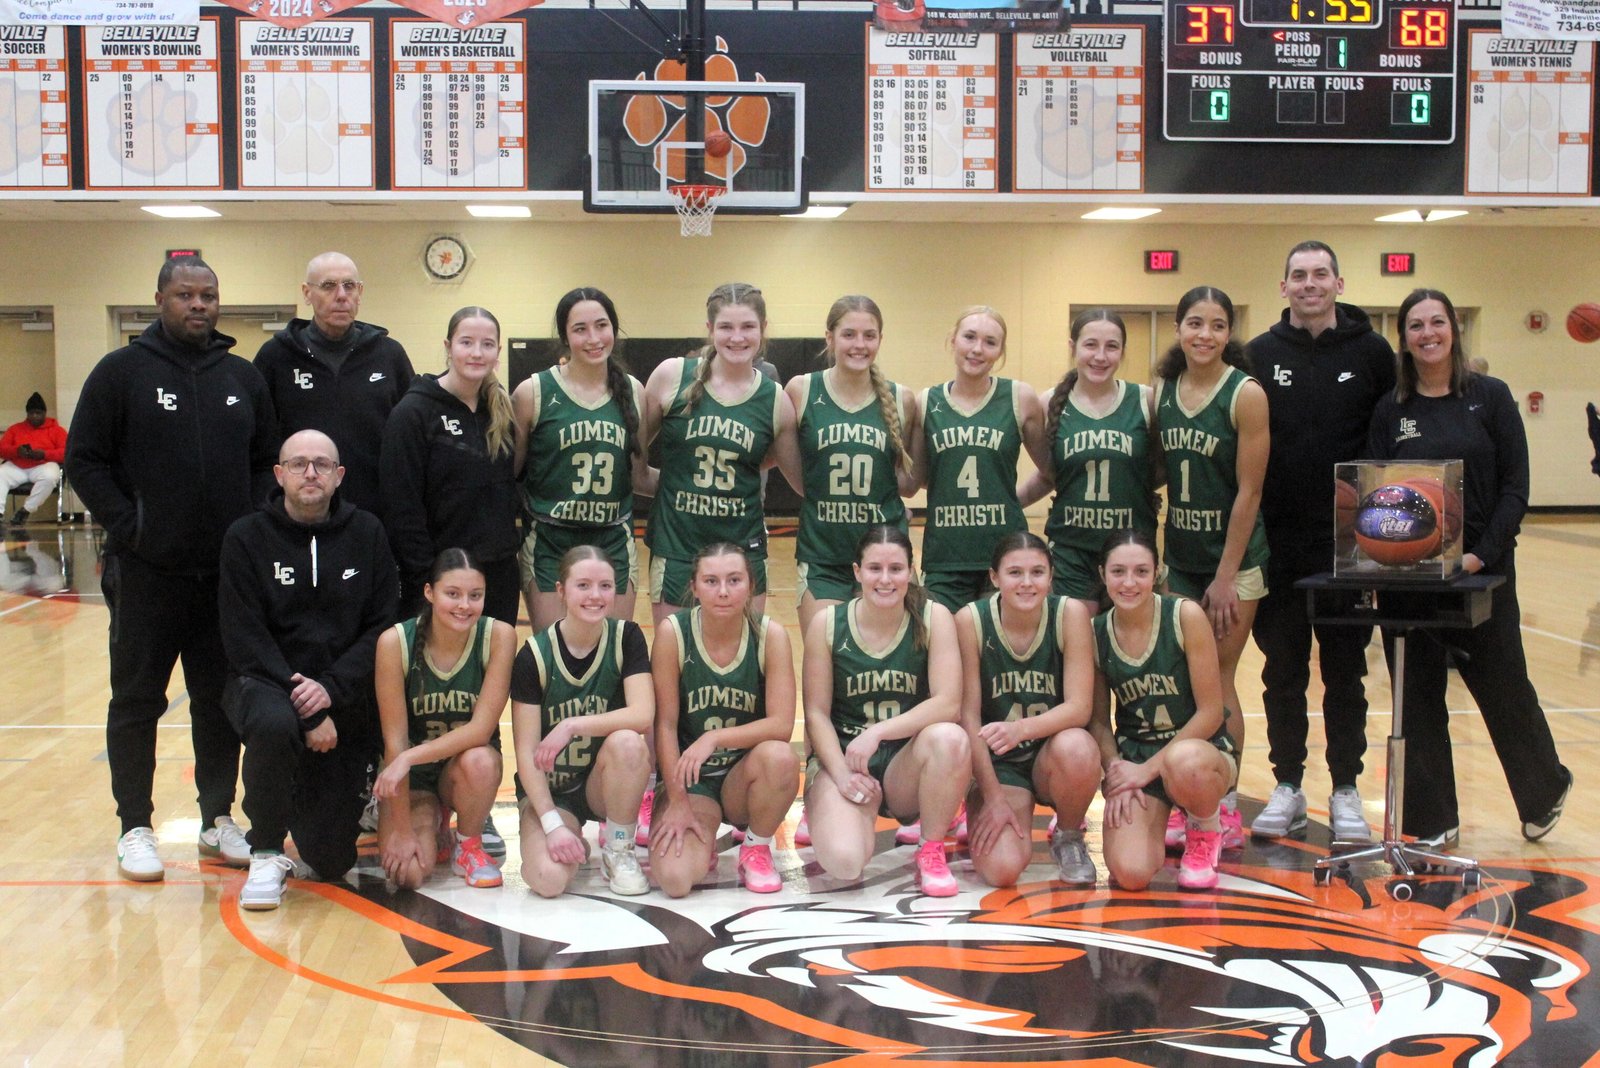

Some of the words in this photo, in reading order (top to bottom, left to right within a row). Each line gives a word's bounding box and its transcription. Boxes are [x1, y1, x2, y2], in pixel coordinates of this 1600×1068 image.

[269, 0, 313, 17] 2024
[20, 12, 48, 20] Come
[1186, 6, 1232, 44] 37
[1400, 10, 1446, 46] 68
[102, 26, 199, 42] BELLEVILLE
[256, 27, 354, 43] BELLEVILLE
[410, 28, 506, 44] BELLEVILLE
[1285, 32, 1311, 42] POSS
[885, 33, 979, 48] BELLEVILLE
[1032, 34, 1126, 49] BELLEVILLE
[4, 43, 46, 54] SOCCER
[102, 44, 150, 55] WOMEN'S
[153, 45, 202, 56] BOWLING
[250, 45, 300, 56] WOMEN'S
[302, 45, 360, 56] SWIMMING
[401, 45, 450, 57] WOMEN'S
[452, 46, 516, 57] BASKETBALL
[1487, 40, 1577, 55] BELLEVILLE
[908, 50, 956, 61] SOFTBALL
[1050, 51, 1108, 62] VOLLEYBALL
[1200, 52, 1242, 65] BONUS
[1275, 44, 1321, 57] PERIOD
[1338, 40, 1346, 68] 1
[1380, 54, 1421, 68] BONUS
[1491, 56, 1536, 67] WOMEN'S
[1539, 57, 1572, 68] TENNIS
[90, 74, 99, 82] 25
[123, 74, 132, 82] 09
[187, 74, 194, 82] 21
[245, 75, 255, 83] 83
[423, 74, 431, 82] 97
[874, 79, 884, 88] 83
[887, 79, 895, 88] 16
[905, 80, 915, 88] 83
[918, 80, 928, 88] 05
[936, 80, 946, 88] 83
[1192, 75, 1231, 88] FOULS
[1269, 76, 1315, 89] PLAYER
[1325, 77, 1364, 90] FOULS
[245, 86, 255, 94] 84
[396, 81, 405, 90] 25
[1392, 78, 1432, 91] FOULS
[1474, 85, 1484, 93] 95
[423, 93, 432, 101] 99
[874, 90, 883, 98] 84
[918, 91, 928, 99] 06
[936, 91, 946, 99] 84
[245, 97, 255, 105] 85
[874, 101, 884, 109] 89
[936, 102, 946, 110] 05
[1210, 91, 1228, 120] 0
[245, 108, 256, 116] 86
[1411, 93, 1429, 123] 0
[125, 112, 132, 120] 14
[873, 112, 882, 120] 91
[918, 112, 926, 121] 12
[245, 119, 256, 127] 99
[423, 121, 432, 129] 06
[874, 123, 884, 131] 93
[918, 123, 926, 131] 13
[126, 131, 132, 139] 17
[246, 130, 256, 138] 00
[874, 133, 884, 142] 09
[246, 141, 256, 149] 04
[918, 145, 926, 153] 15
[246, 152, 256, 160] 08
[918, 156, 927, 164] 16
[918, 166, 927, 174] 19
[1151, 252, 1173, 270] EXIT
[1388, 255, 1409, 272] EXIT
[558, 420, 626, 450] LUMEN
[685, 416, 755, 453] LUMEN
[818, 423, 887, 453] LUMEN
[932, 426, 1004, 454] LUMEN
[1064, 429, 1133, 460] LUMEN
[1160, 427, 1219, 457] LUMEN
[571, 452, 614, 495] 33
[693, 446, 739, 491] 35
[829, 454, 874, 497] 20
[957, 455, 980, 498] 4
[1085, 460, 1110, 502] 11
[1181, 460, 1190, 502] 1
[675, 490, 746, 517] CHRISTI
[550, 500, 621, 523] CHRISTI
[817, 501, 886, 524] CHRISTI
[935, 504, 1006, 527] CHRISTI
[1064, 508, 1133, 529] CHRISTI
[846, 670, 917, 697] LUMEN
[992, 670, 1056, 699] LUMEN
[1115, 673, 1179, 706] LUMEN
[688, 685, 756, 713] LUMEN
